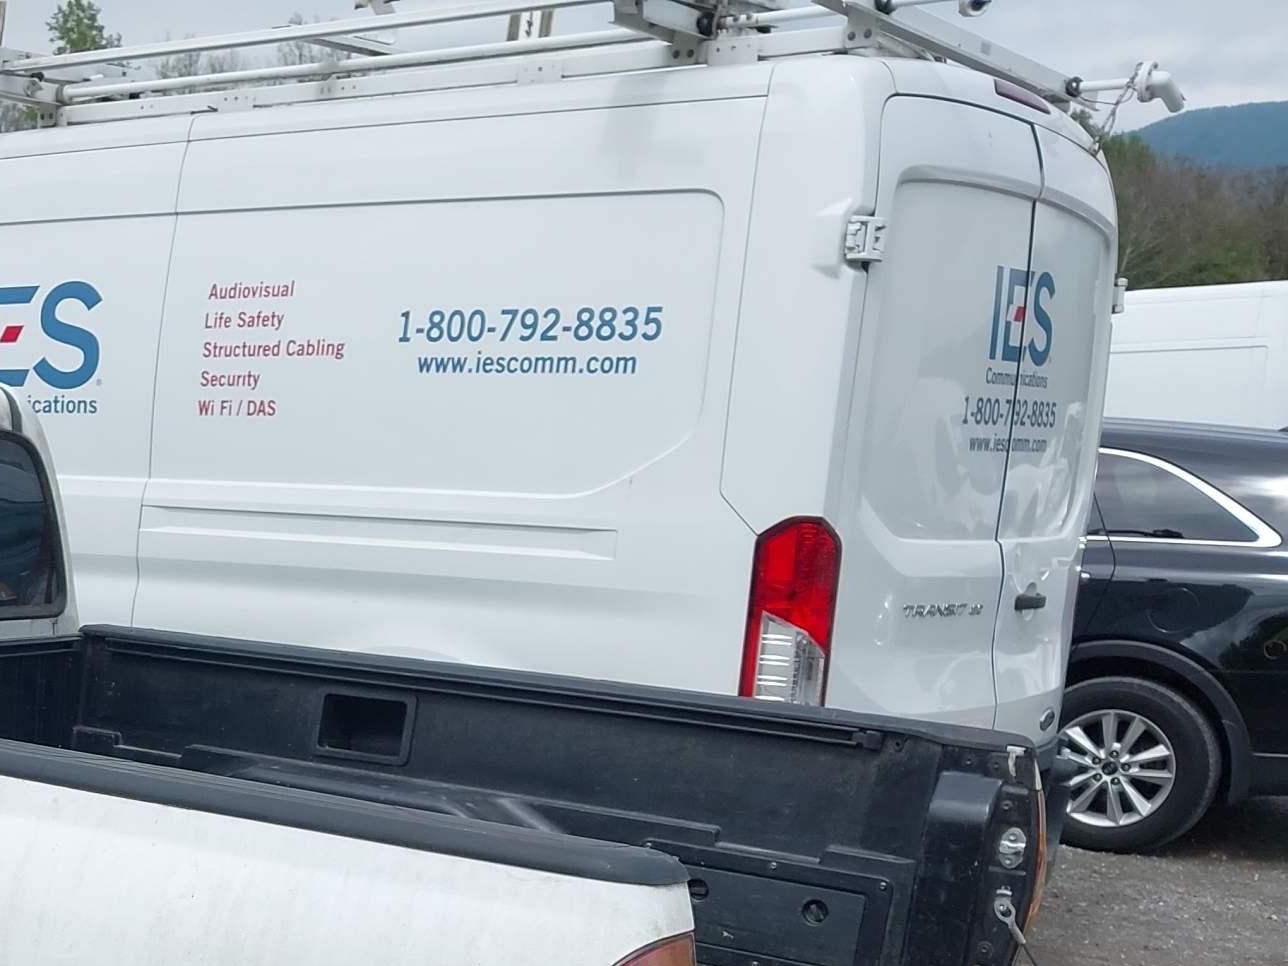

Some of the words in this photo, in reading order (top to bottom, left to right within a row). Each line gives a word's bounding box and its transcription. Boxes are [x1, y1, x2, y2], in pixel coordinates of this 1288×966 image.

[208, 280, 296, 300] Audiovisual
[204, 312, 232, 329] Life
[237, 310, 285, 331] Safety
[398, 306, 663, 343] 1-800-792-8835
[988, 265, 1056, 367] IES
[202, 340, 281, 358] Structured
[286, 338, 346, 360] Cabling
[417, 350, 637, 374] www.iescomm.com
[200, 370, 261, 390] Security
[198, 399, 215, 416] Wi
[220, 399, 233, 416] Fi
[247, 399, 277, 416] DAS
[962, 395, 1057, 428] 1-800-792-8835
